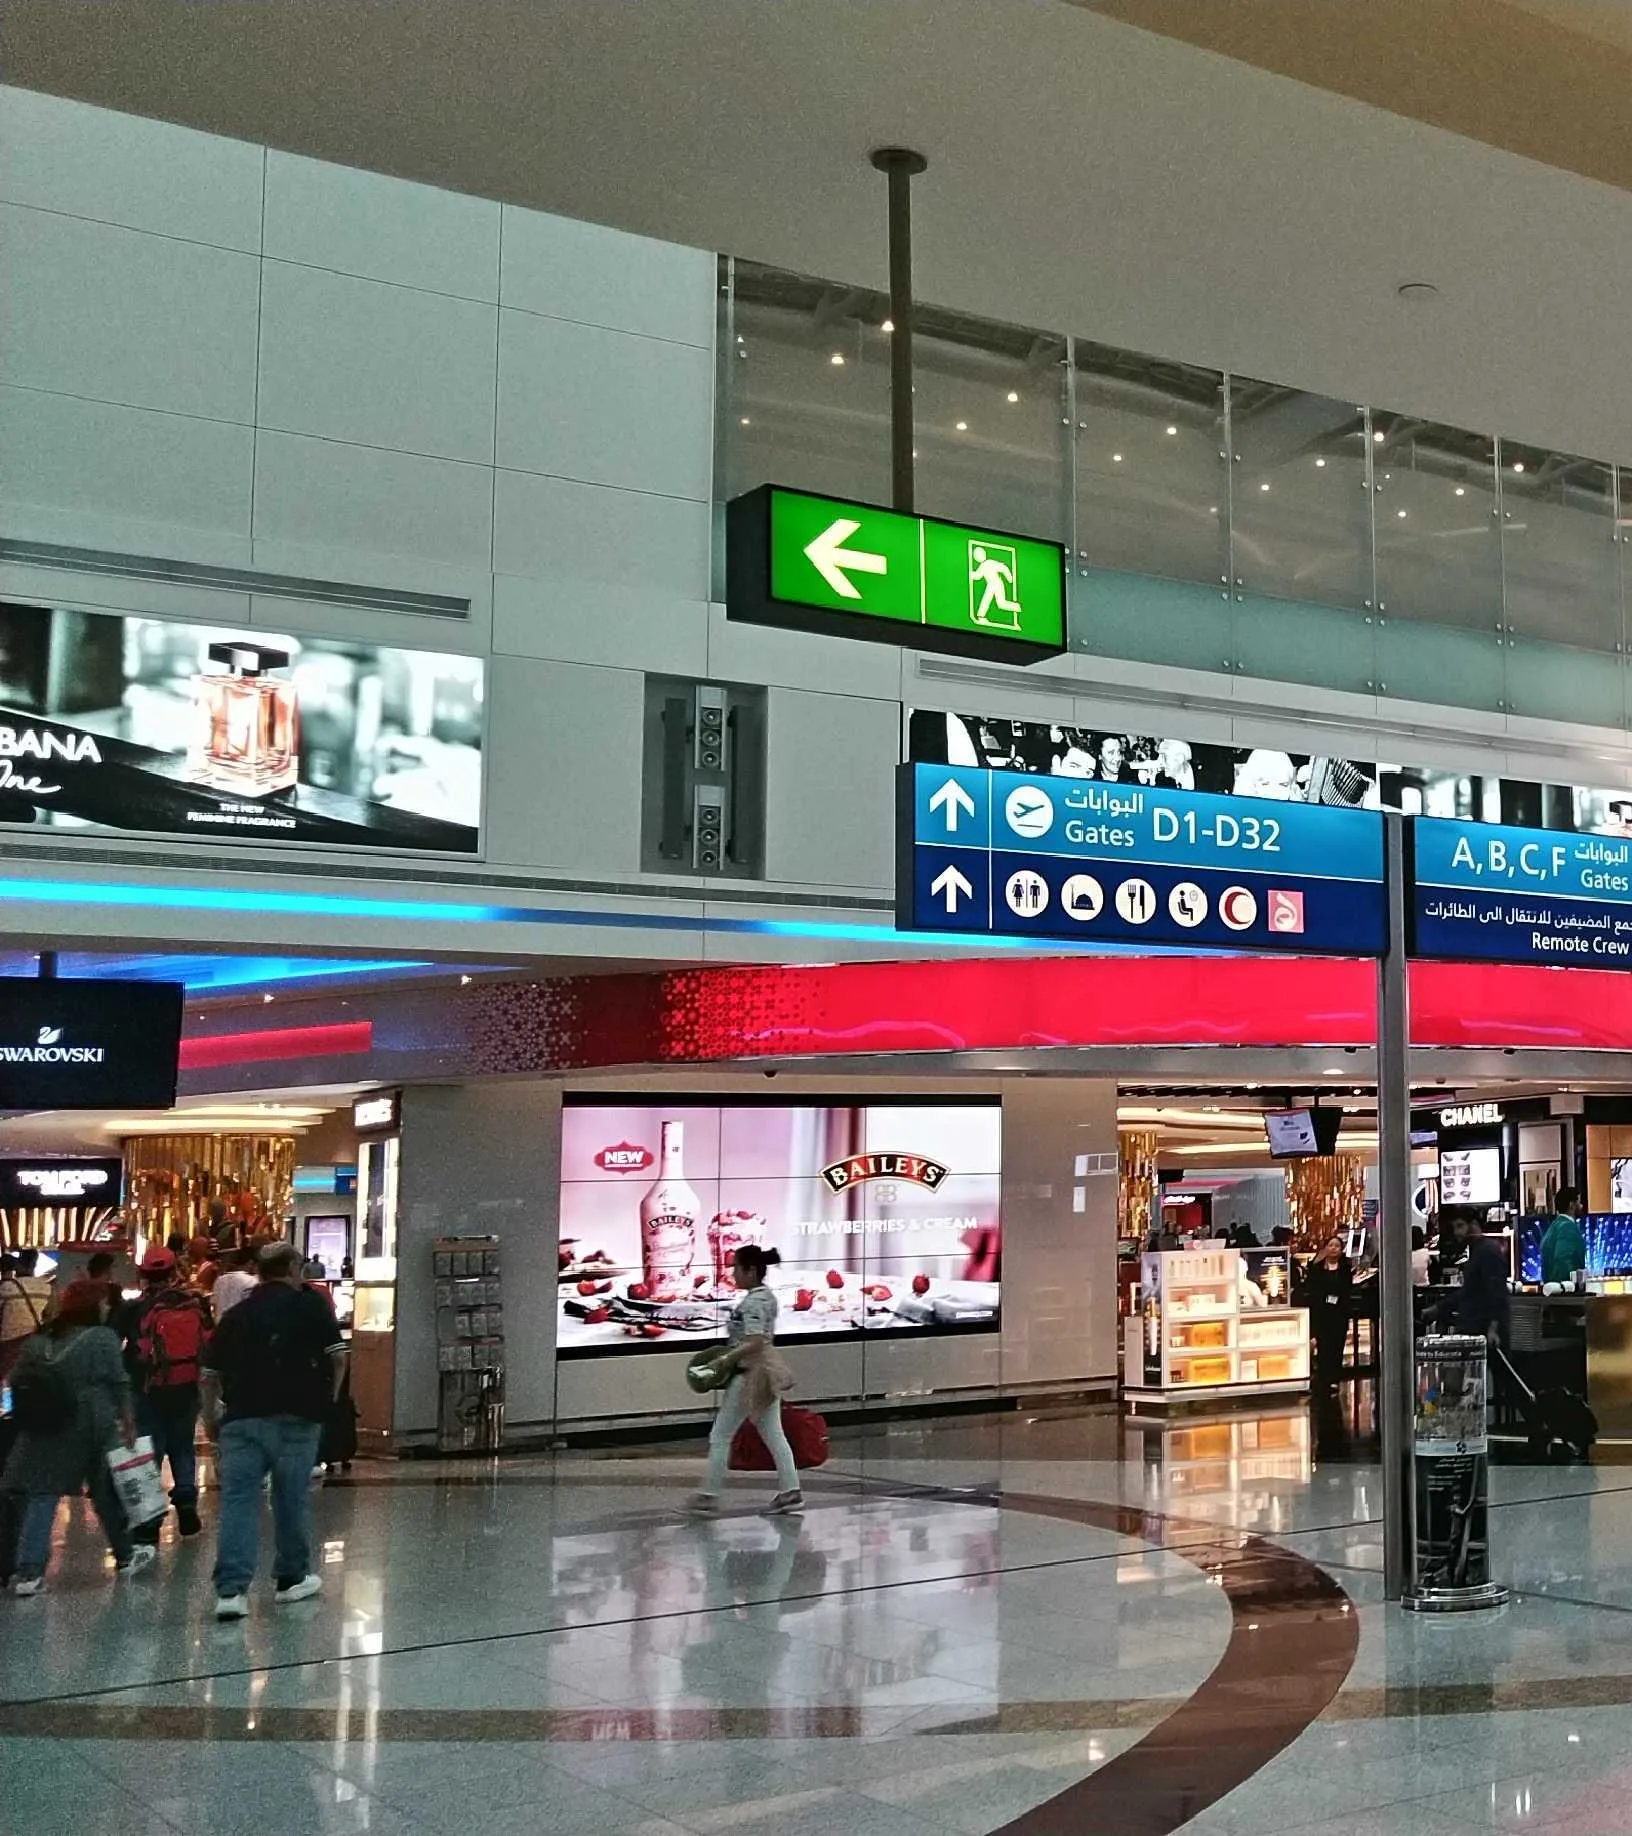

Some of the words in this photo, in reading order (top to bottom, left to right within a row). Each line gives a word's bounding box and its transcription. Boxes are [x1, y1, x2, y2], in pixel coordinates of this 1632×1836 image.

[1065, 788, 1143, 818] البوابات
[1065, 820, 1135, 847] Gates
[1153, 807, 1280, 851] D1-D32
[1574, 841, 1628, 867] البوابات
[1580, 869, 1629, 891] Gates
[1532, 932, 1589, 952] Remote
[1593, 936, 1630, 955] Crew
[1440, 1104, 1506, 1127] CHANEL
[605, 1151, 644, 1164] NEW
[829, 1156, 941, 1187] BAILEYS
[791, 1220, 906, 1236] STRAWBERRIES
[923, 1217, 977, 1230] CREAM
